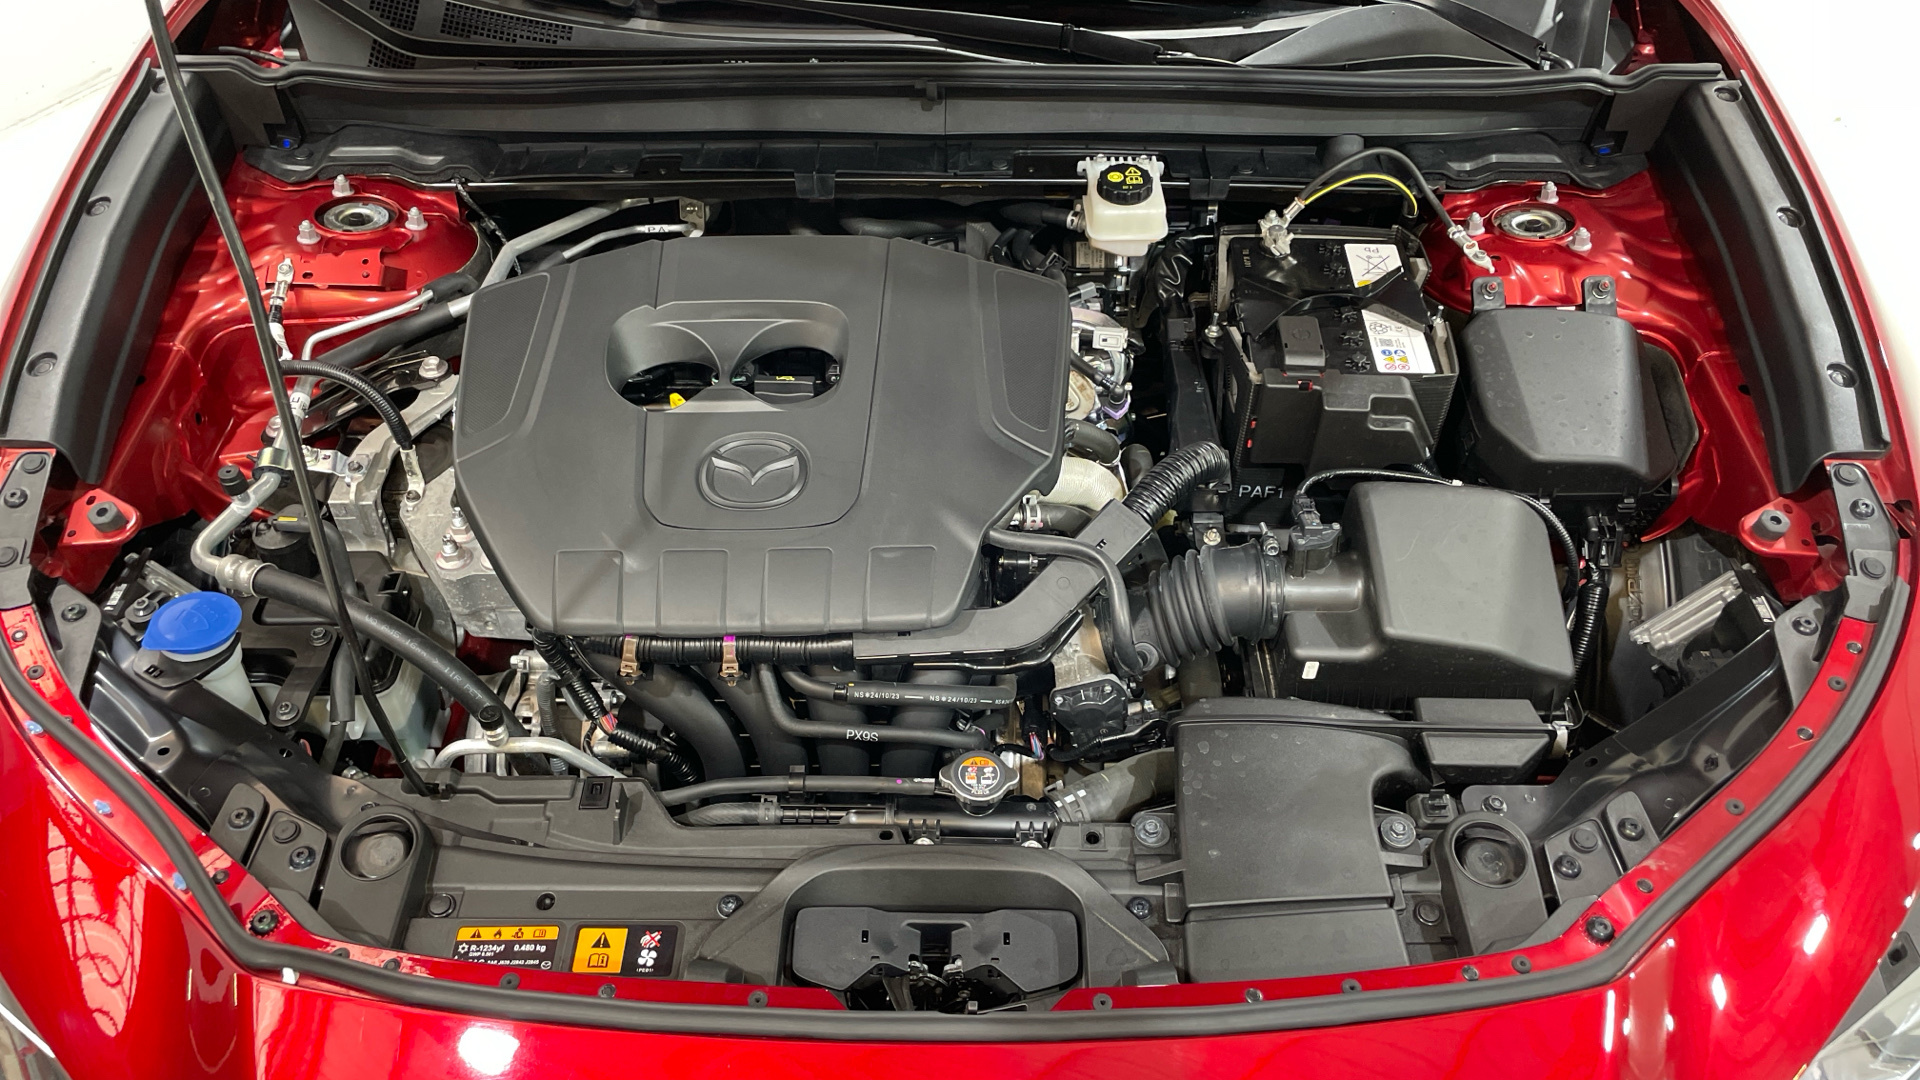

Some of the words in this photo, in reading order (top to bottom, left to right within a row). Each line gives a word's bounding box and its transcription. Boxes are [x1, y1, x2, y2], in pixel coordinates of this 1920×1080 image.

[1238, 484, 1284, 499] PAF1
[846, 729, 879, 742] PX9S
[469, 944, 505, 953] R-1234yf
[513, 944, 535, 952] 0.480
[536, 943, 547, 952] kg
